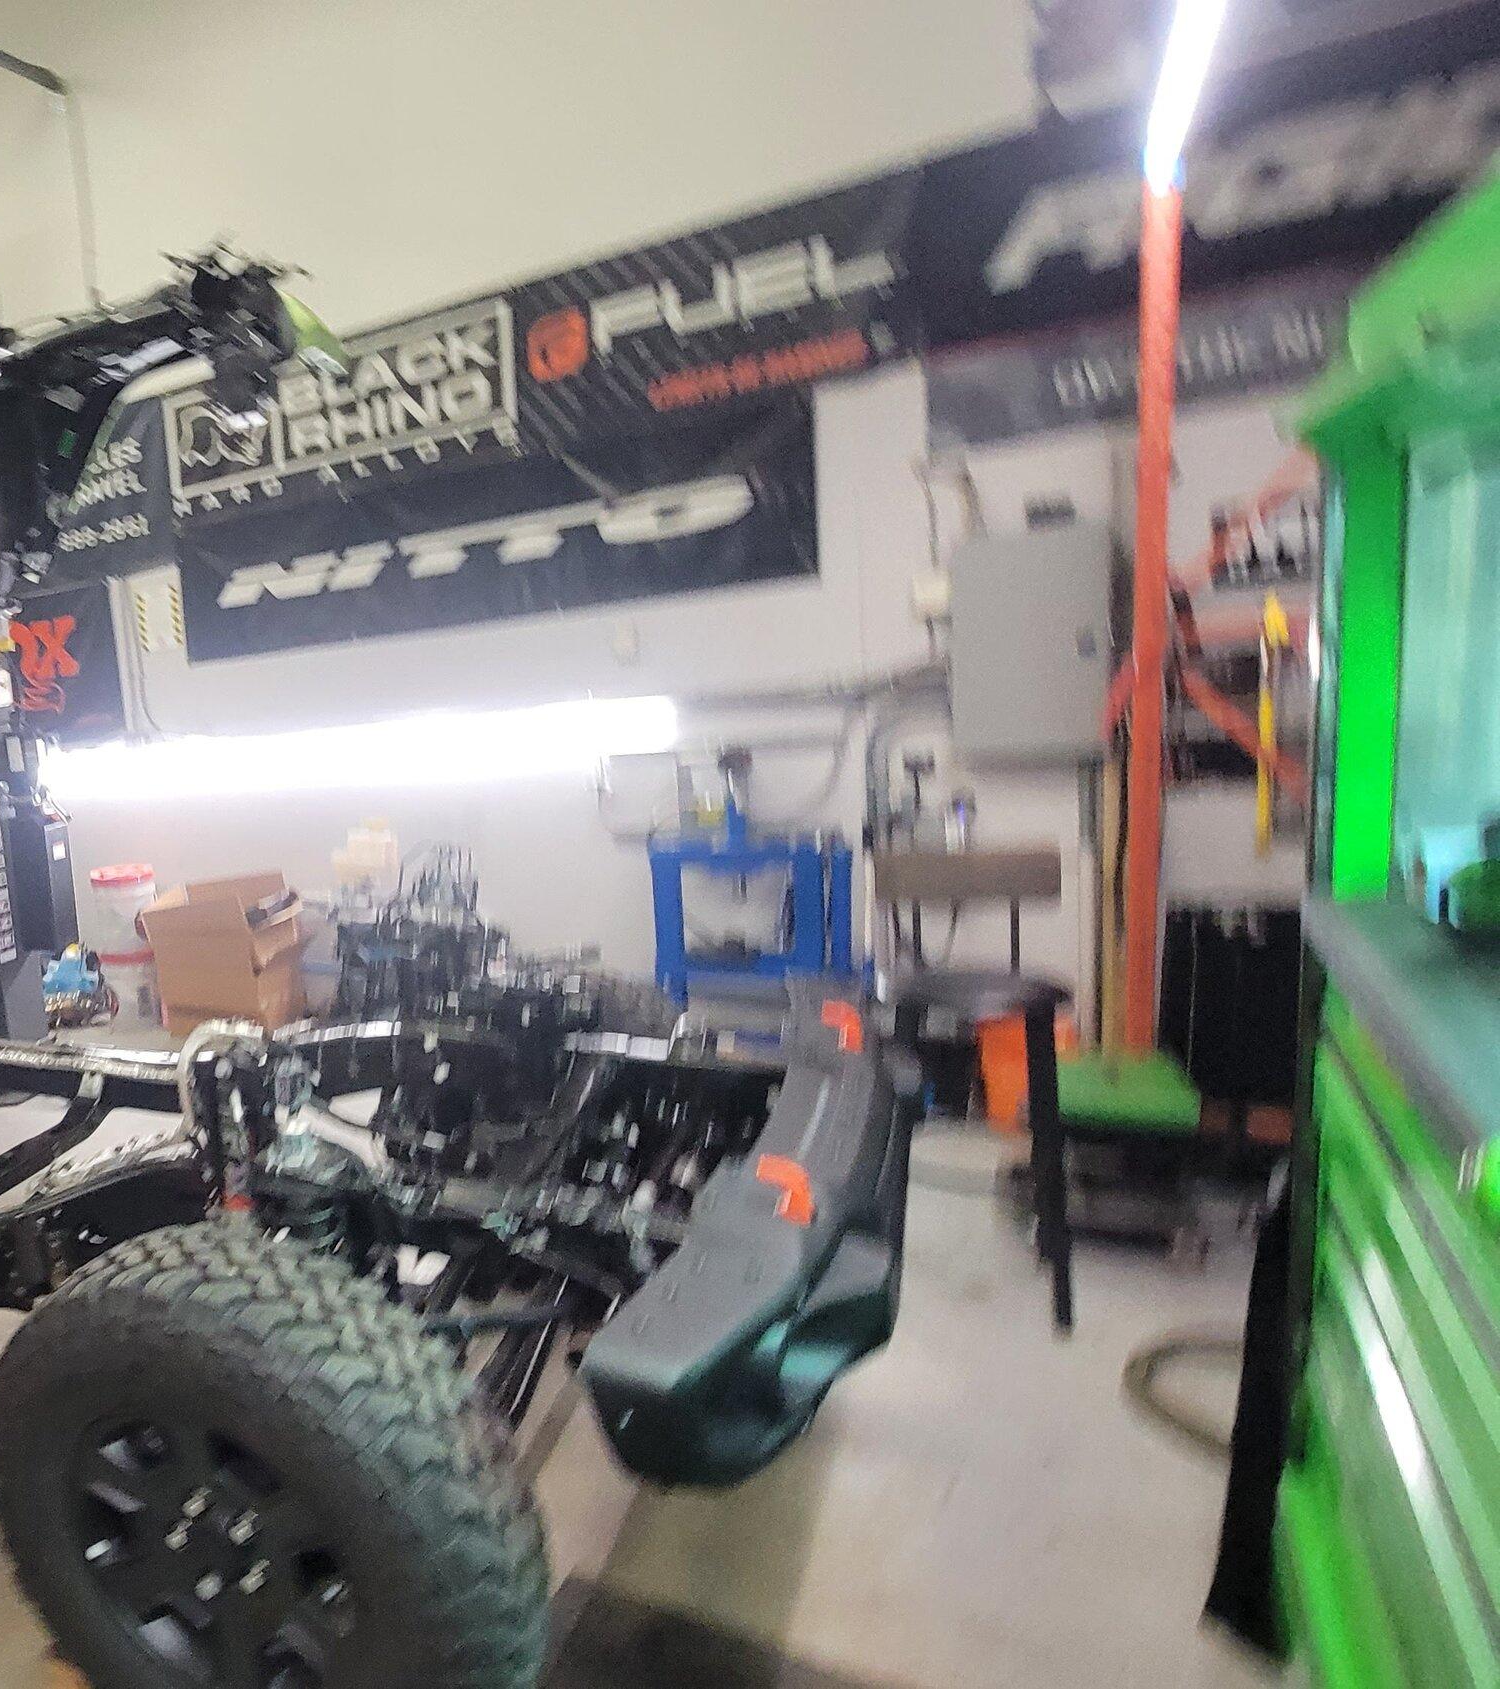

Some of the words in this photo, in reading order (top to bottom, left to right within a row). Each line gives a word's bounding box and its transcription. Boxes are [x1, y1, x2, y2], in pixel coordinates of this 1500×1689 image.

[590, 233, 896, 356] FUEL
[274, 316, 498, 416] BLACK
[289, 367, 492, 458] RHINO
[217, 472, 756, 609] NITTO
